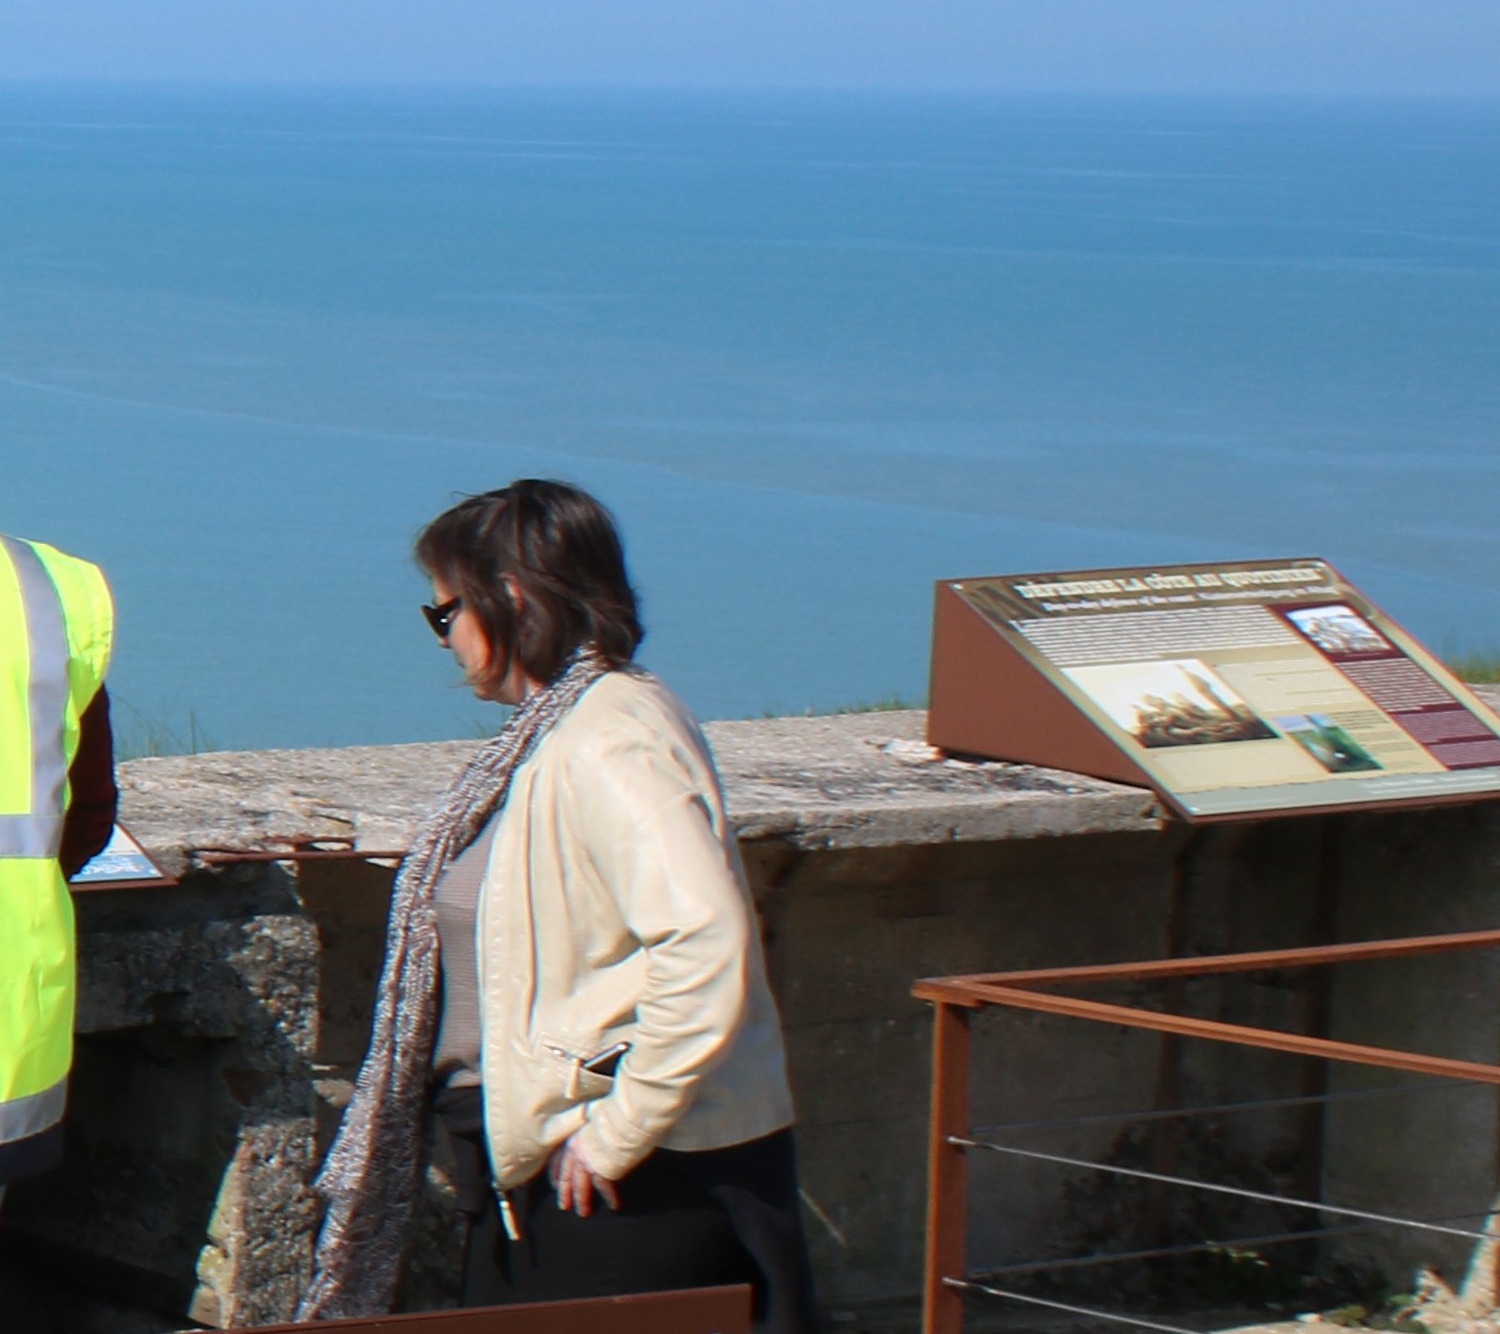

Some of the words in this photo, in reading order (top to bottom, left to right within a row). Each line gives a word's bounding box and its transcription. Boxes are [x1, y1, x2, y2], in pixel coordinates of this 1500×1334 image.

[1115, 576, 1150, 592] LA
[1143, 573, 1197, 590] CÔTE
[1191, 573, 1223, 587] AU
